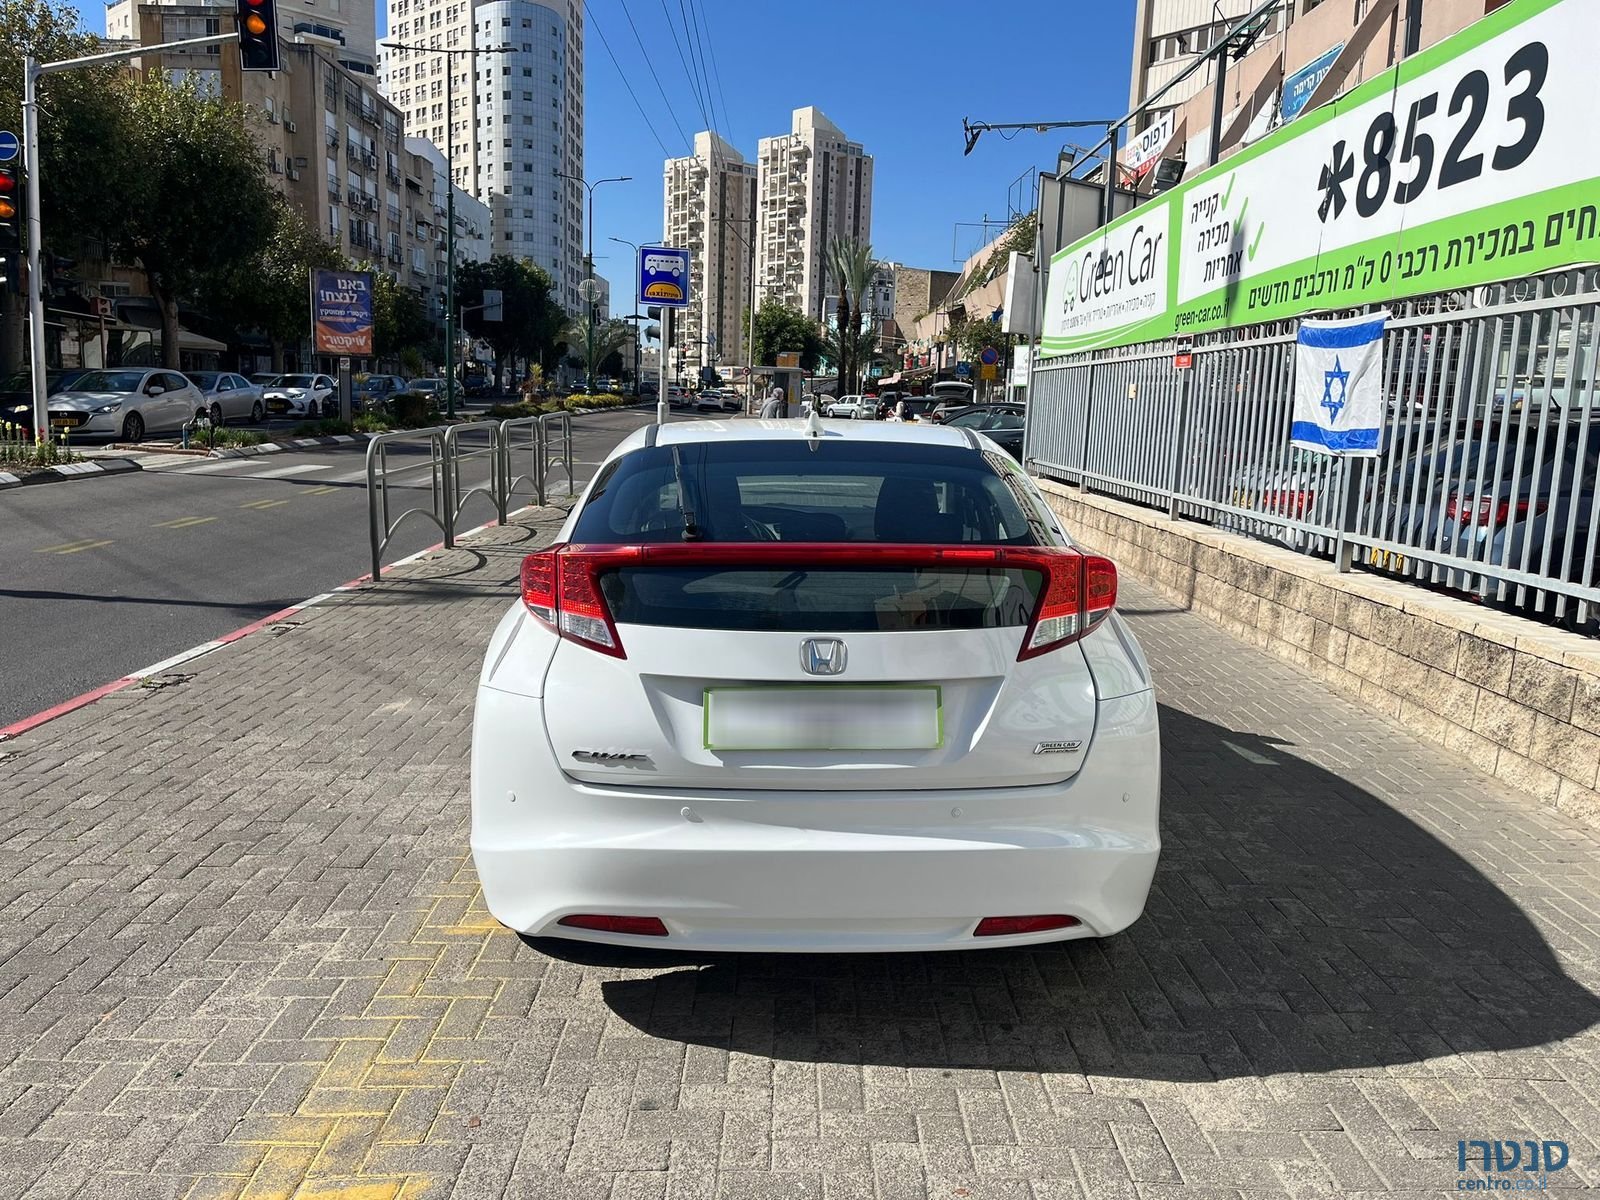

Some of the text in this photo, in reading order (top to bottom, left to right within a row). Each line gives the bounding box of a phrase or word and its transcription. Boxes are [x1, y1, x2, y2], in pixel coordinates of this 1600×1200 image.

[1293, 75, 1314, 96] קדימה
[1142, 121, 1167, 152] דפוס
[1191, 193, 1219, 224] קנייה
[1197, 221, 1230, 252] מכירה
[1544, 205, 1600, 248] חים
[1444, 220, 1535, 270] במכירת
[1079, 225, 1162, 303] Green Car
[1203, 249, 1244, 283] אחריות
[1380, 250, 1392, 282] 0
[1396, 244, 1439, 279] רכבי
[320, 289, 358, 303] לנצח!
[336, 279, 366, 291] באנו
[1248, 279, 1290, 309] חדשים
[1292, 268, 1339, 301] ורכבים
[1174, 297, 1230, 331] green-car.co.il
